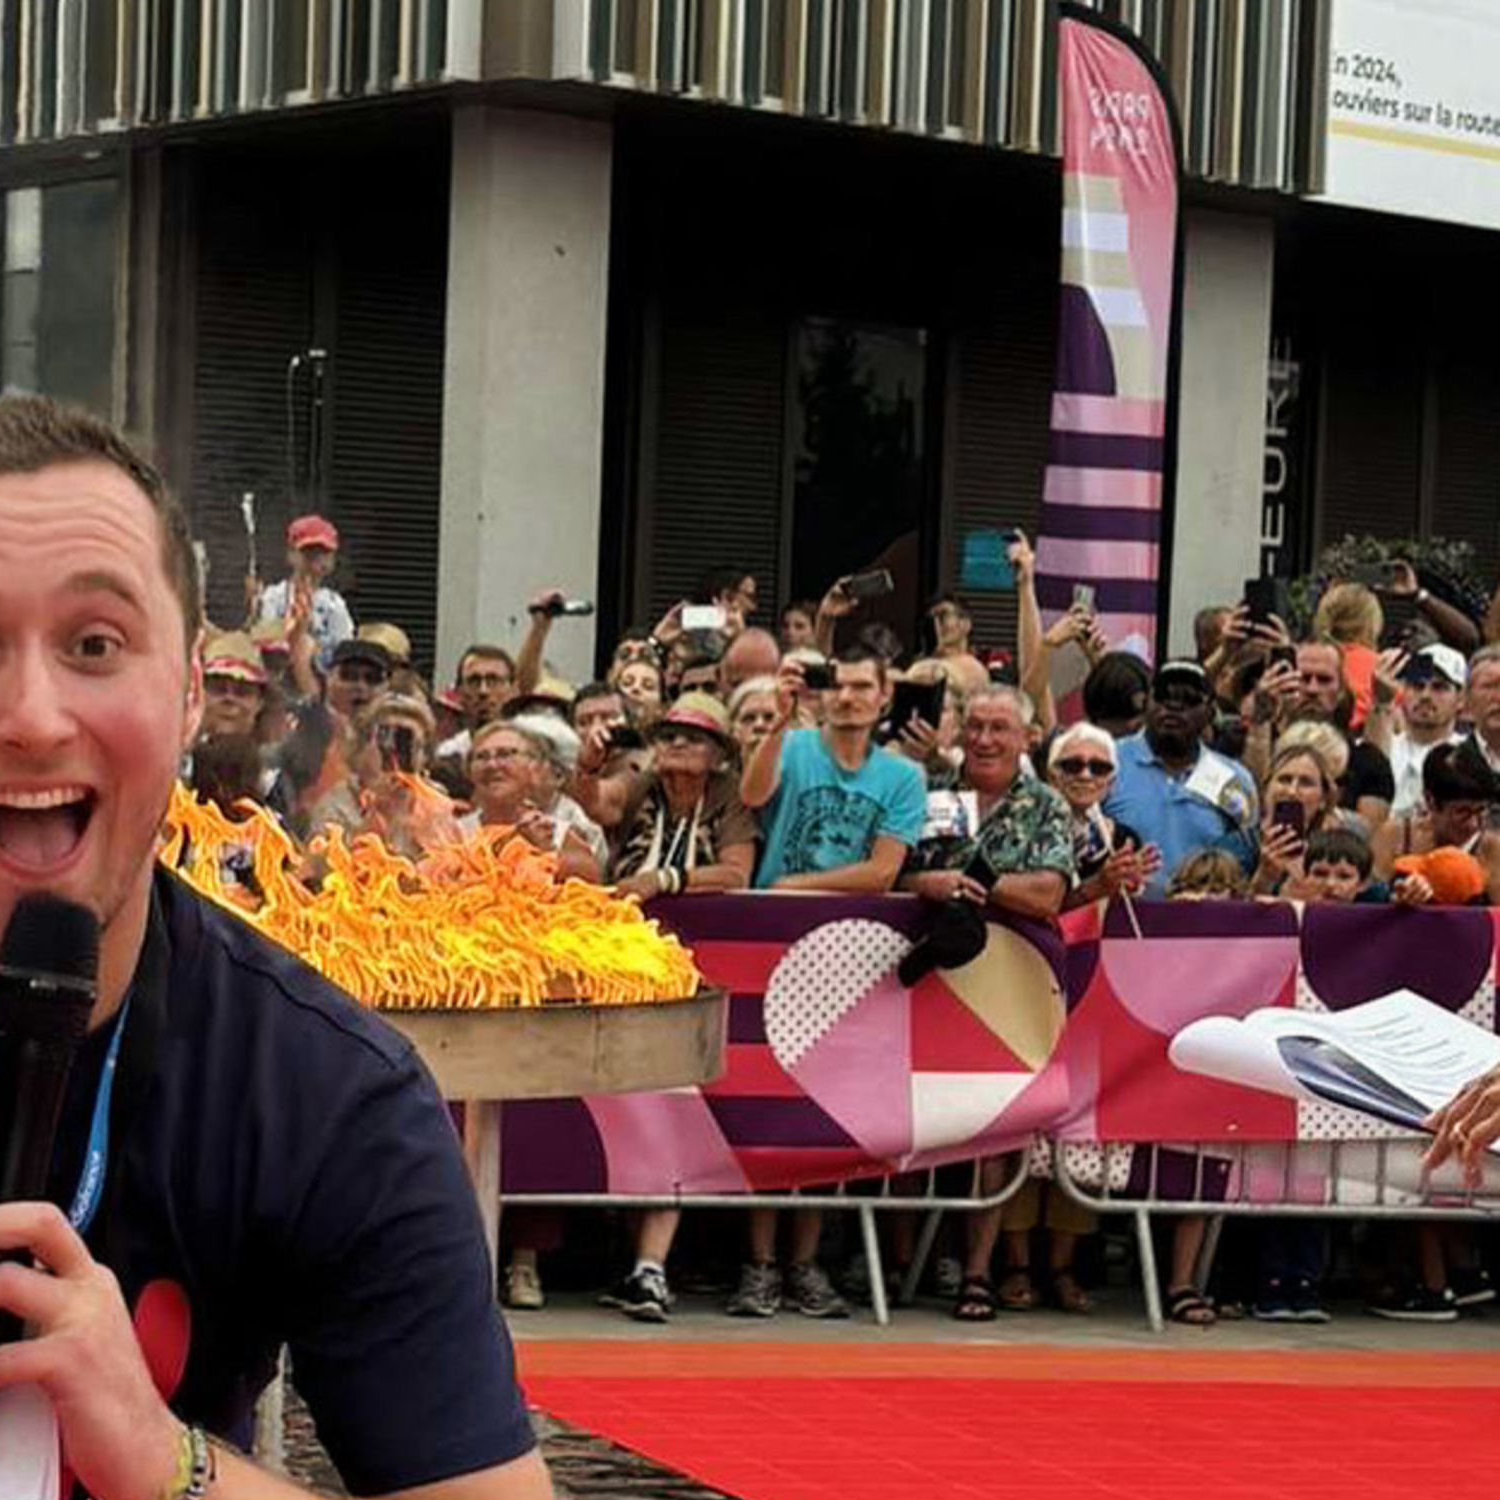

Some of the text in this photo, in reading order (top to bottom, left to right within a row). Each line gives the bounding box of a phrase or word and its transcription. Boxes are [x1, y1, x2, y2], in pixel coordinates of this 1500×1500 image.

[1331, 54, 1402, 87] n 2024,
[1333, 88, 1400, 118] ouviers
[1404, 101, 1433, 122] sur
[1436, 102, 1452, 128] la
